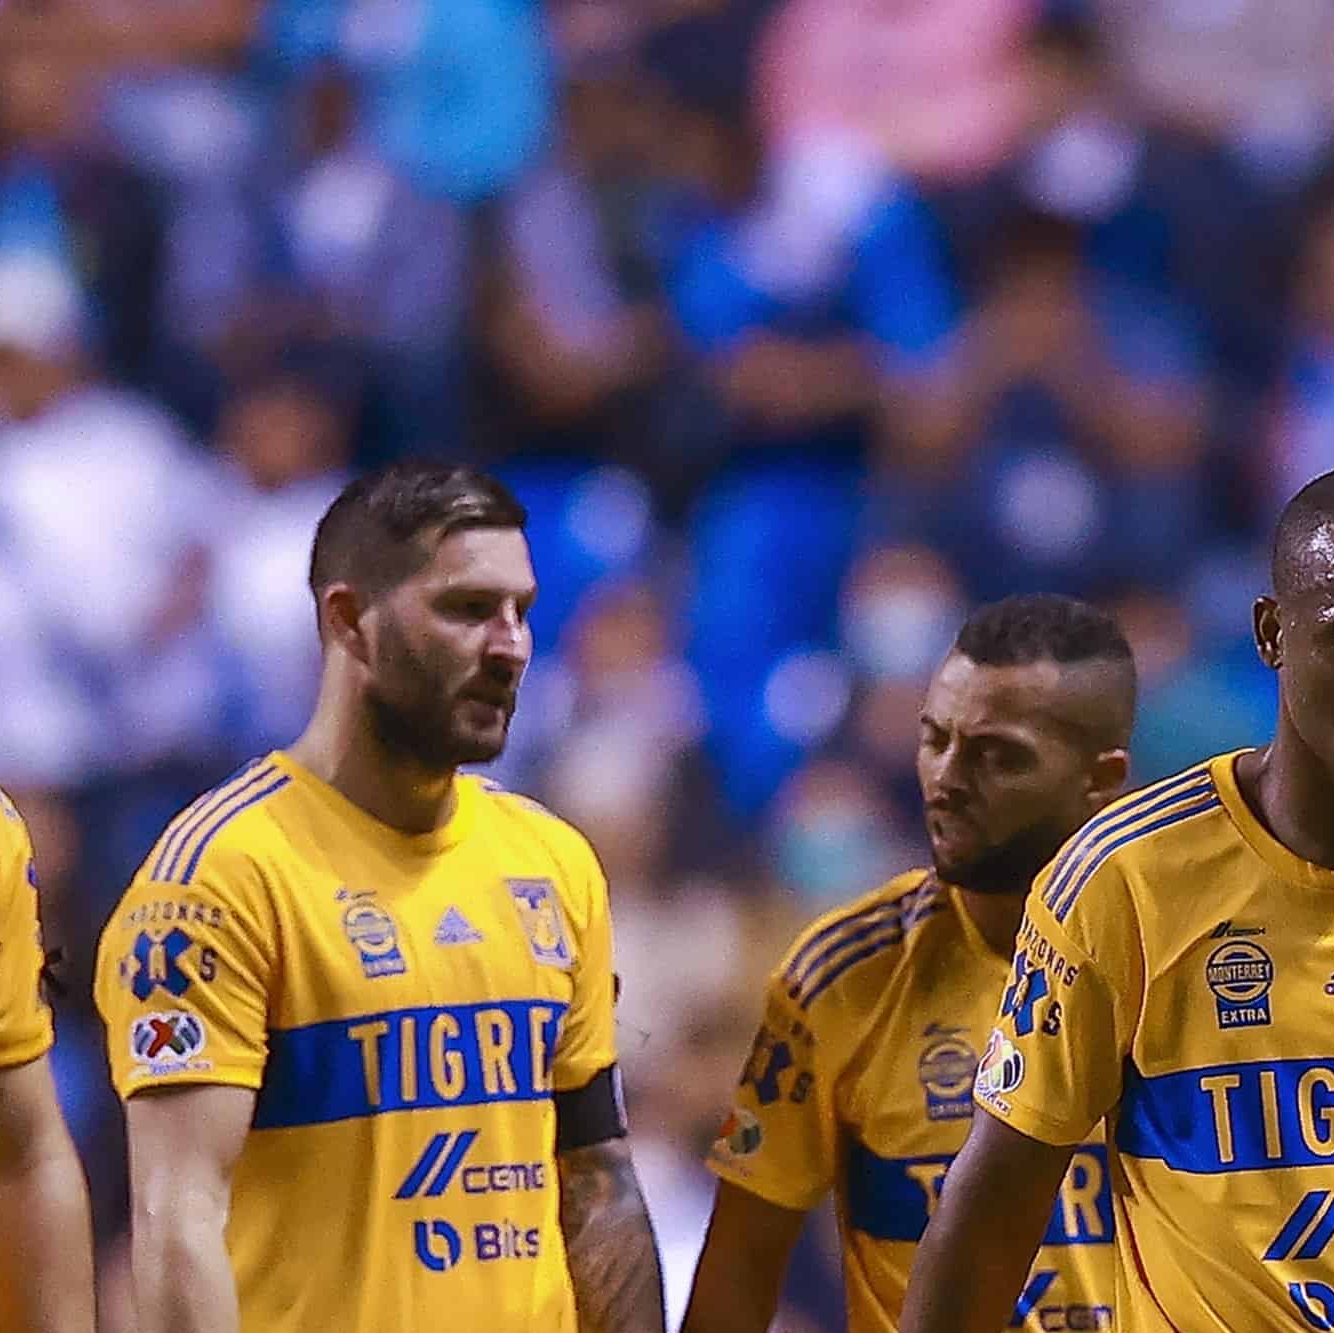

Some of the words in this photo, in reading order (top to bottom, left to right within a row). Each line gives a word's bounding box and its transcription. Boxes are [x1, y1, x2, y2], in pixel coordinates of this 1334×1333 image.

[1208, 962, 1271, 983] MONTERREY
[1220, 1008, 1268, 1024] EXTRA
[347, 1007, 560, 1106] TIGRE
